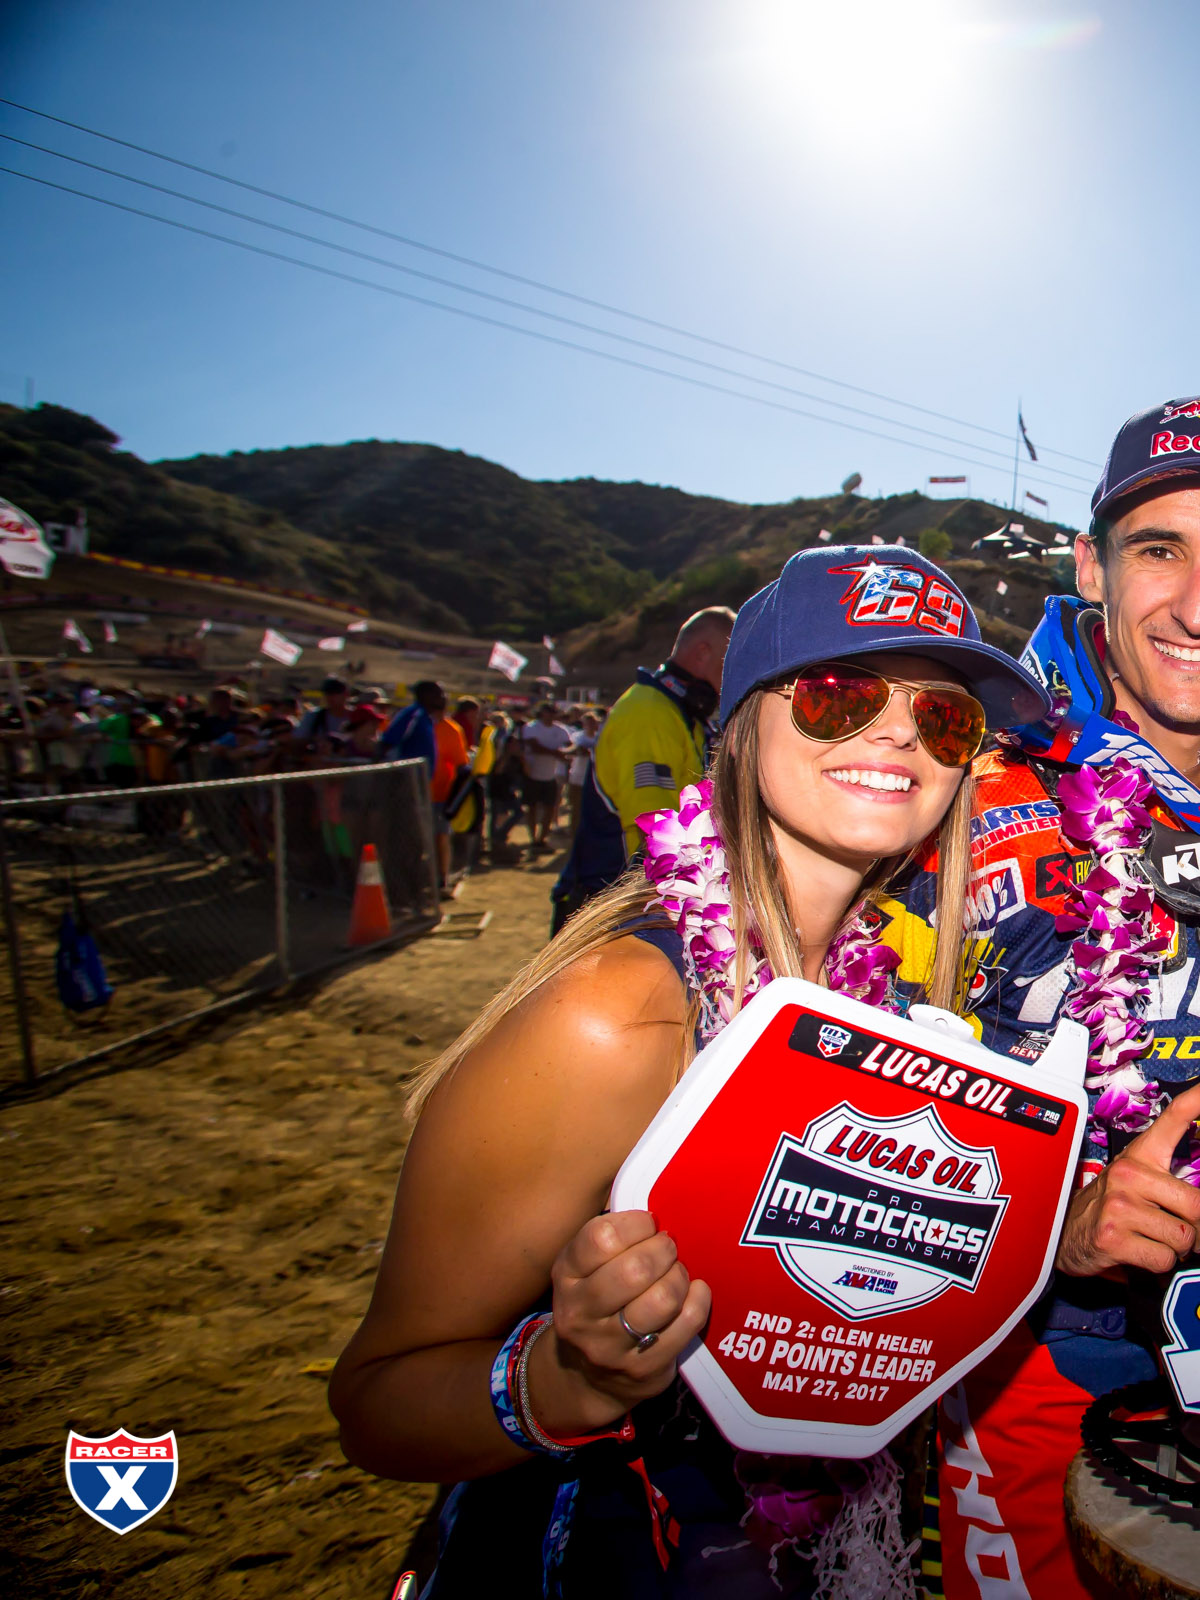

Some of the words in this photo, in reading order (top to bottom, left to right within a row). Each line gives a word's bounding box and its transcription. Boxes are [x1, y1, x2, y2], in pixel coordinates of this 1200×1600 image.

[846, 564, 967, 637] 69
[970, 800, 1061, 841] ARTS
[859, 1042, 967, 1099] LUCAS
[965, 1077, 1014, 1117] OIL
[1045, 1108, 1061, 1121] PRO
[823, 1125, 935, 1180] LUCAS
[932, 1156, 982, 1191] OIL
[769, 1178, 988, 1254] MOTOCROSS
[867, 1189, 922, 1211] PRO
[765, 1208, 978, 1265] CHAMPIONSHIP
[832, 1270, 875, 1291] AMA
[876, 1278, 898, 1290] PRO
[852, 1264, 886, 1277] SANCTIONED
[875, 1287, 896, 1295] RACING
[744, 1310, 792, 1335] RND
[796, 1320, 816, 1339] 2:
[821, 1325, 873, 1348] GLEN
[876, 1334, 933, 1355] HELEN
[718, 1331, 766, 1362] 450
[769, 1339, 857, 1376] POINTS
[859, 1353, 936, 1382] LEADER
[762, 1371, 809, 1393] MAY
[811, 1379, 839, 1400] 27,
[845, 1382, 889, 1402] 2017
